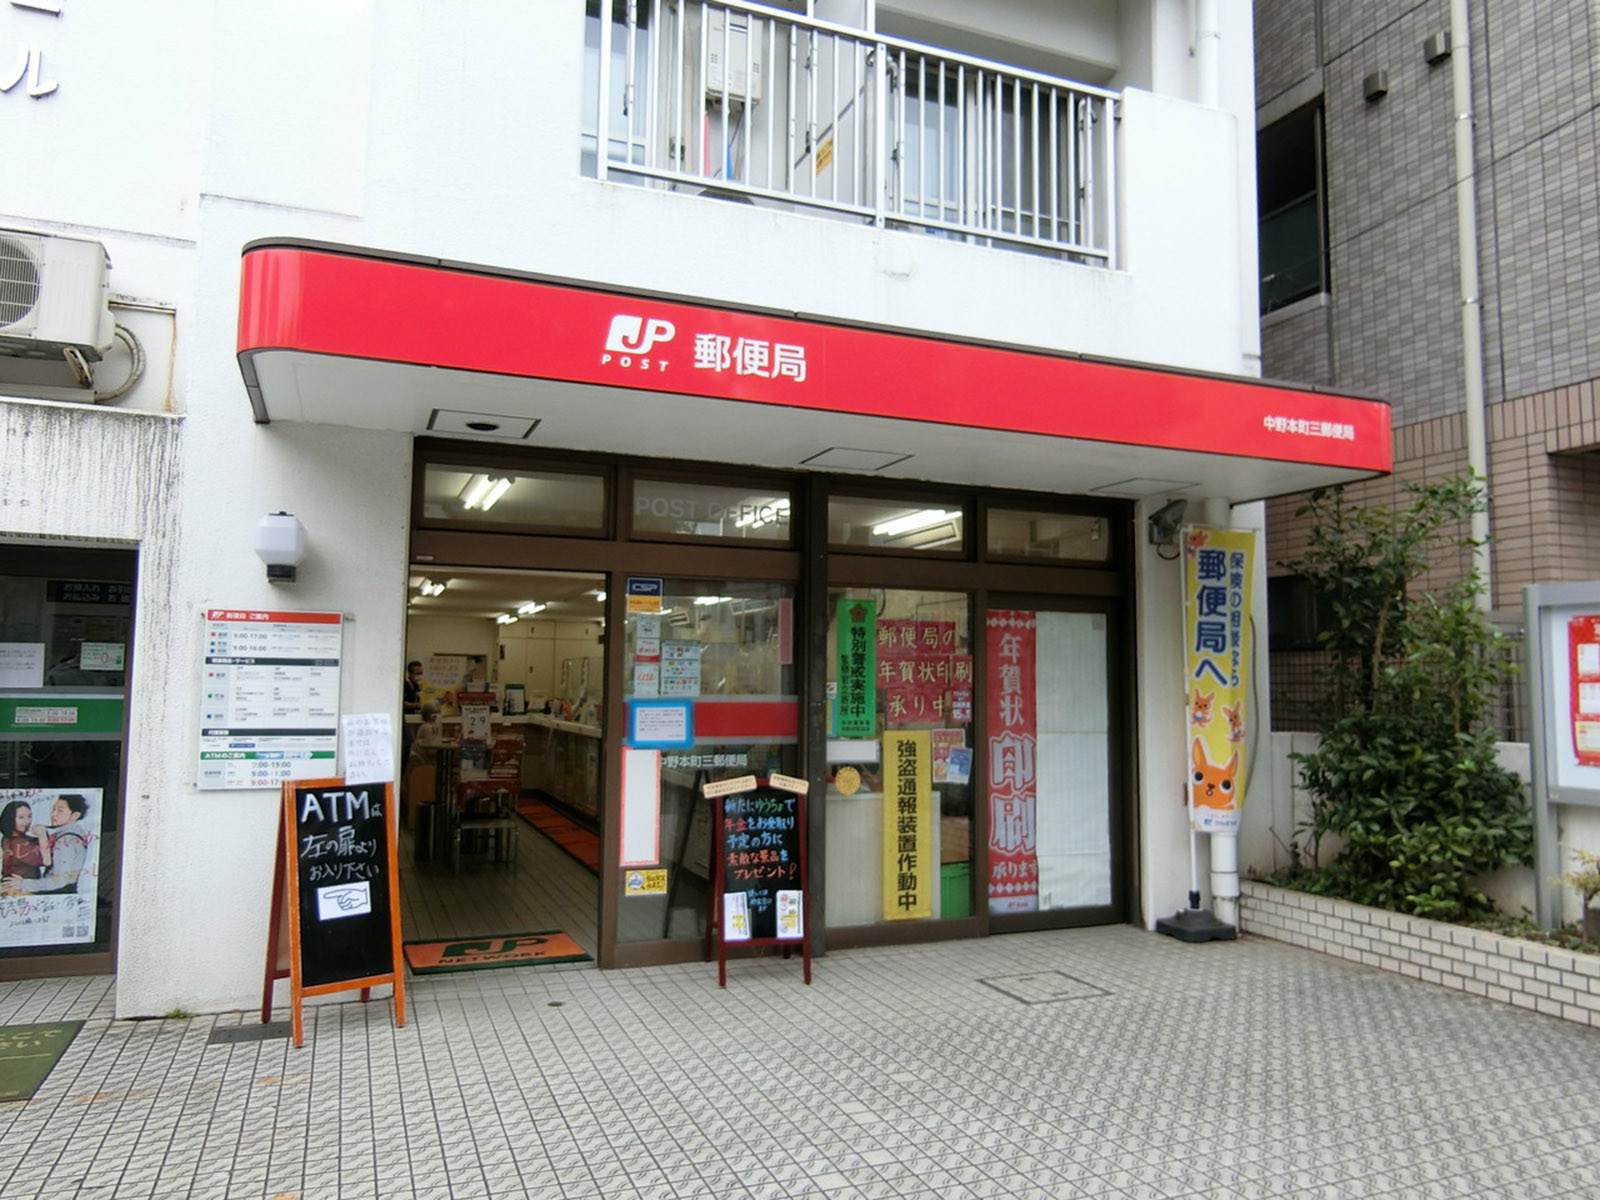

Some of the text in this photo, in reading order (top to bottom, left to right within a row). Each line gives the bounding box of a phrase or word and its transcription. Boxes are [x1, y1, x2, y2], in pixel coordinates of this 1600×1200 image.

[604, 314, 807, 382] JP 郵便局
[601, 353, 670, 372] POST
[1263, 415, 1355, 440] 中野本町三郵便局
[635, 495, 789, 525] POST OFFICE
[631, 583, 658, 592] CSP
[1194, 549, 1227, 686] 郵便局へ
[878, 625, 956, 649] 郵便局の
[850, 626, 866, 718] 特別警戒実施中
[879, 660, 972, 684] 年賀状印刷
[888, 695, 945, 718] 承り中
[301, 790, 383, 823] ATMは
[896, 739, 918, 910] 強盗通報装置作動中
[301, 825, 377, 858] 左の扉より
[727, 831, 783, 849] 予定の方に
[728, 849, 789, 867] 素敵な景品を
[309, 862, 380, 882] お入り下さい
[439, 951, 547, 964] NETWORK
